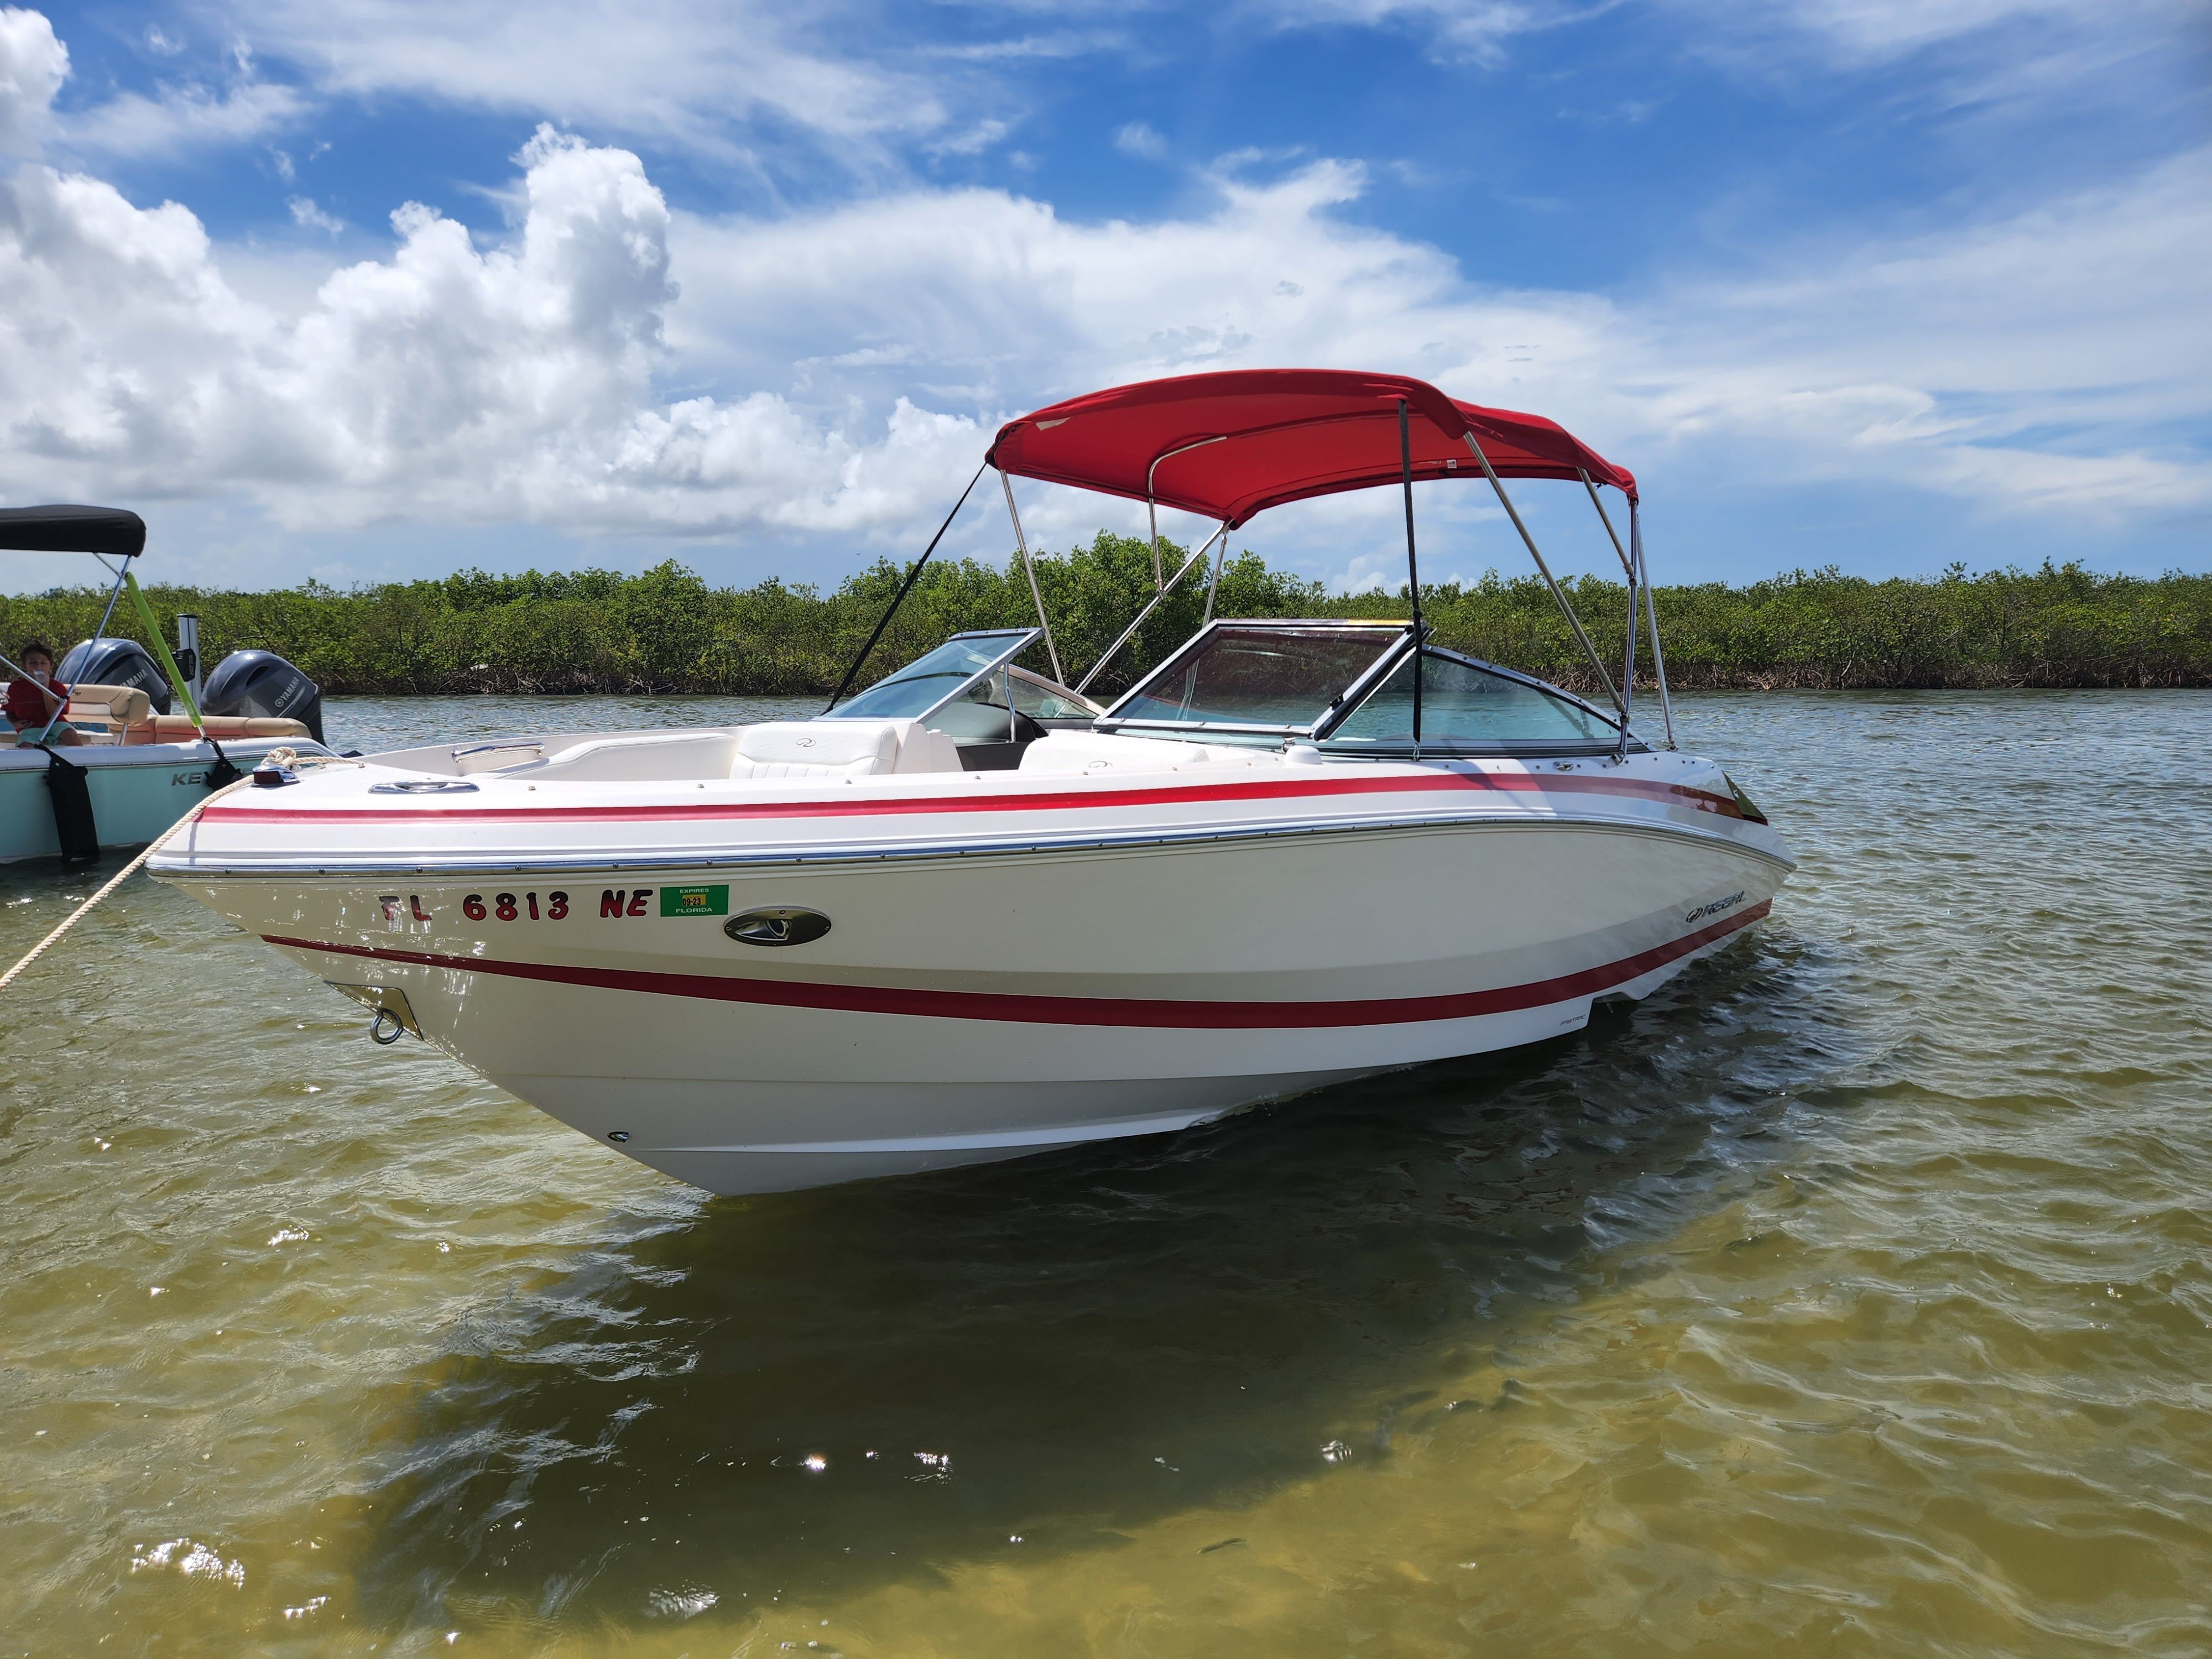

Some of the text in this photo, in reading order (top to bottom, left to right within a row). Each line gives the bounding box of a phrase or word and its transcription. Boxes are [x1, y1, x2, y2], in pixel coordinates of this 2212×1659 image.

[119, 669, 149, 687] AMAHA
[280, 676, 300, 701] YAMAHA
[379, 889, 653, 921] FL 6813 NE
[682, 898, 701, 906] 09-23
[1702, 890, 1747, 917] REGAL
